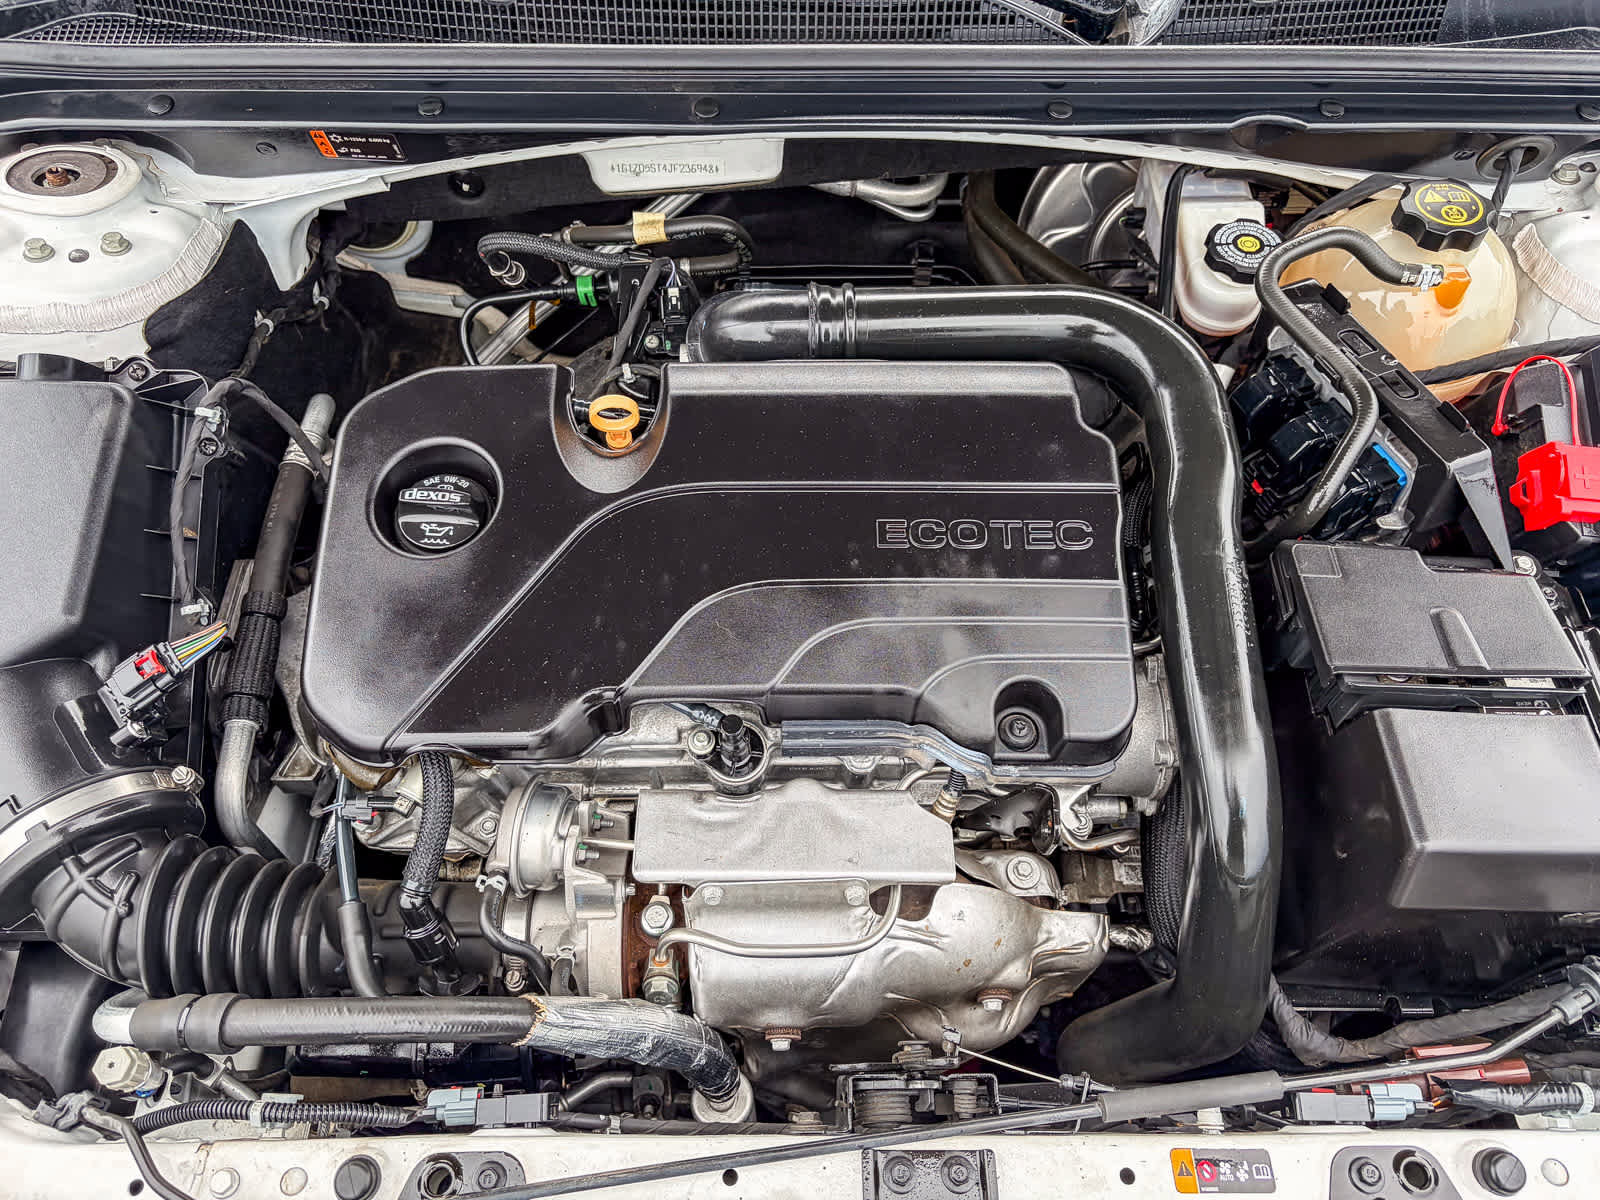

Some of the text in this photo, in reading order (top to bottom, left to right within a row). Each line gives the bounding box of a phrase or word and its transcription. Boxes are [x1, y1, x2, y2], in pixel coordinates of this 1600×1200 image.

[423, 475, 470, 488] SAE 0W-20
[404, 488, 461, 503] dexos
[875, 518, 1094, 550] ECOTEC
